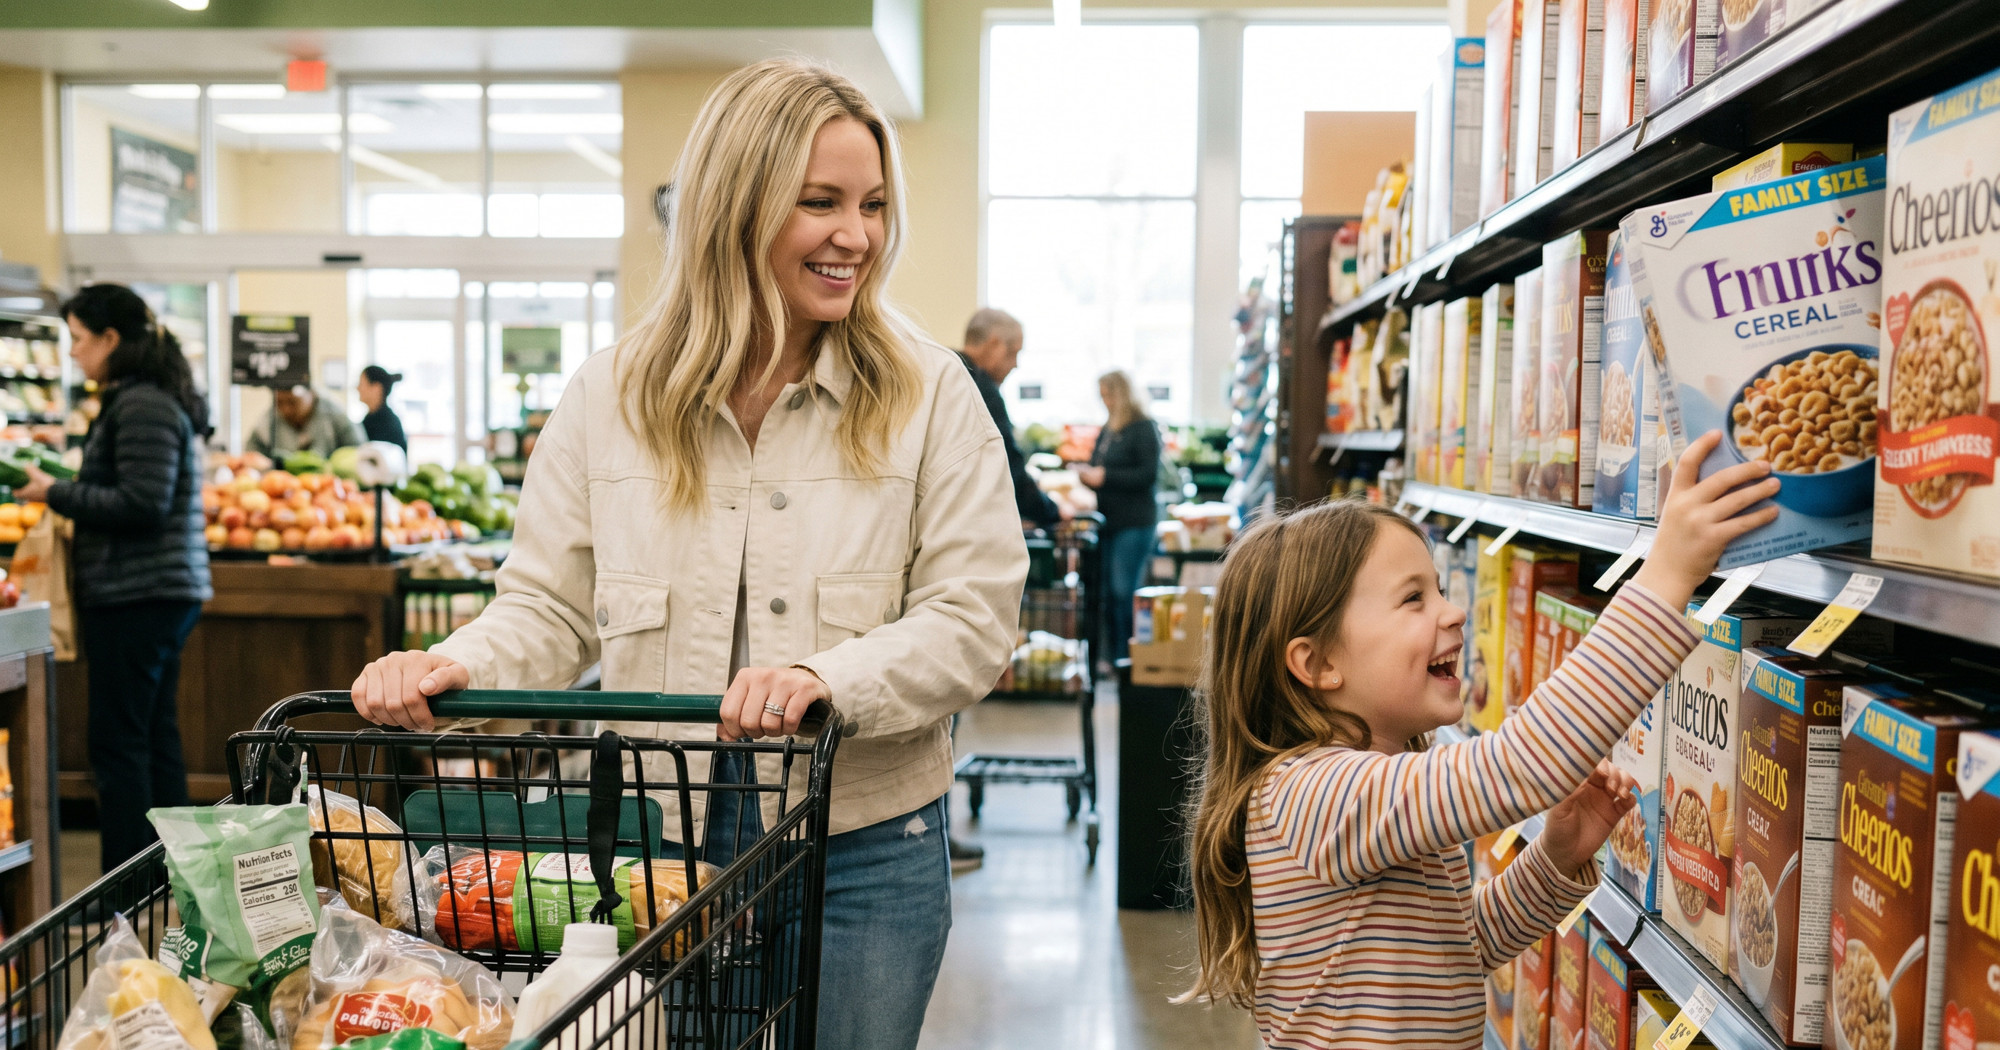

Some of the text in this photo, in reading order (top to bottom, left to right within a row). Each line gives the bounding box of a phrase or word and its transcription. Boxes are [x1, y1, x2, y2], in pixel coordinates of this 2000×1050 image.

[1928, 87, 1979, 130] FAMILY
[1729, 167, 1869, 217] FAMILY SIZE
[1735, 303, 1838, 339] CEREAL
[1712, 619, 1731, 644] SIZE
[1755, 665, 1796, 706] FAMILY SIZE
[1864, 707, 1922, 760] FAMILY SIZE
[243, 893, 276, 906] Calories
[283, 883, 298, 895] 250
